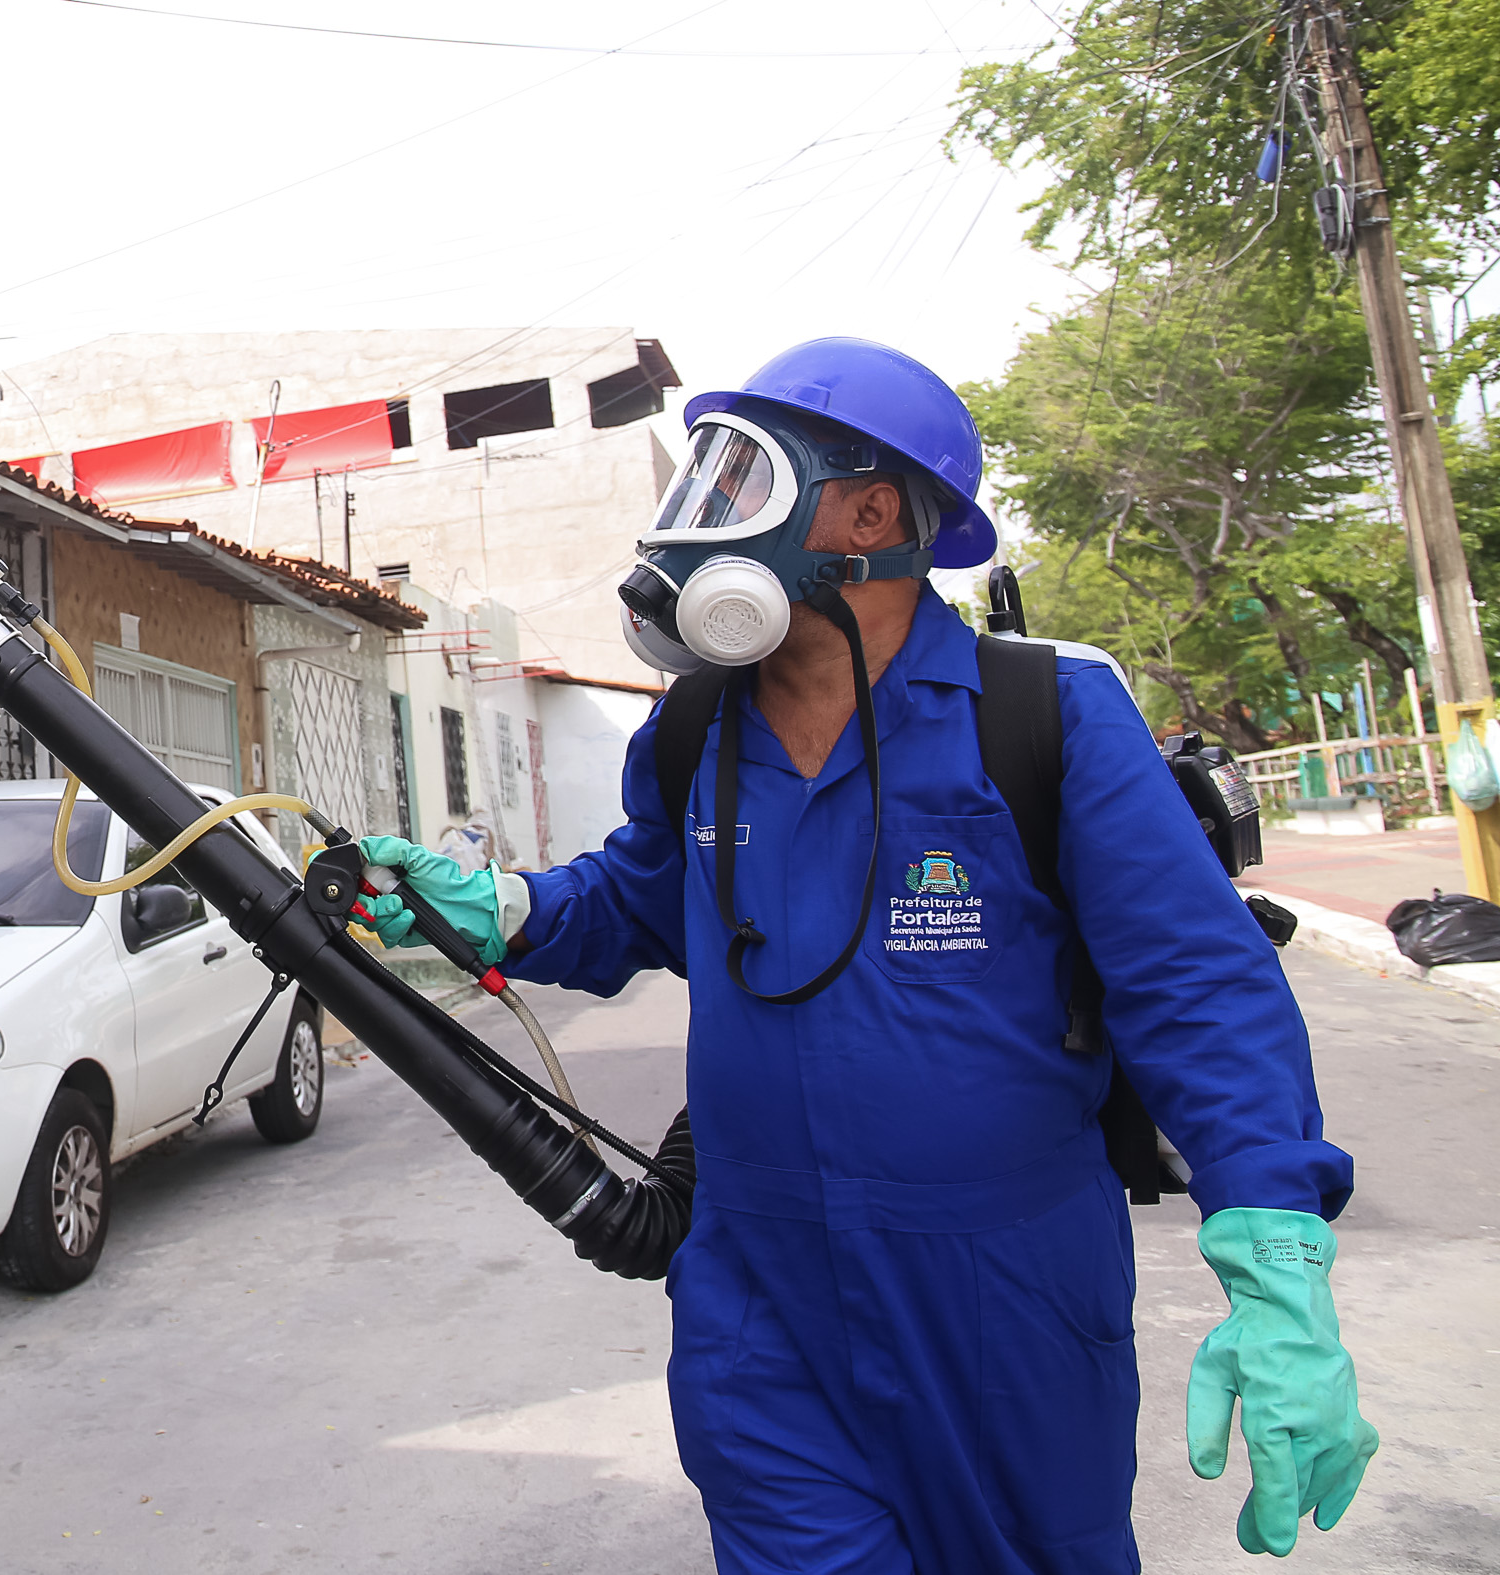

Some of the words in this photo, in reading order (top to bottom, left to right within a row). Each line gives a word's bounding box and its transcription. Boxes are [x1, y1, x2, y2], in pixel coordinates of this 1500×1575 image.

[890, 897, 962, 908] Prefeitura
[965, 896, 982, 907] de
[890, 909, 981, 926] Fortaleza
[884, 936, 940, 951] VIGILÂNCIA
[940, 938, 989, 951] AMBIENTAL
